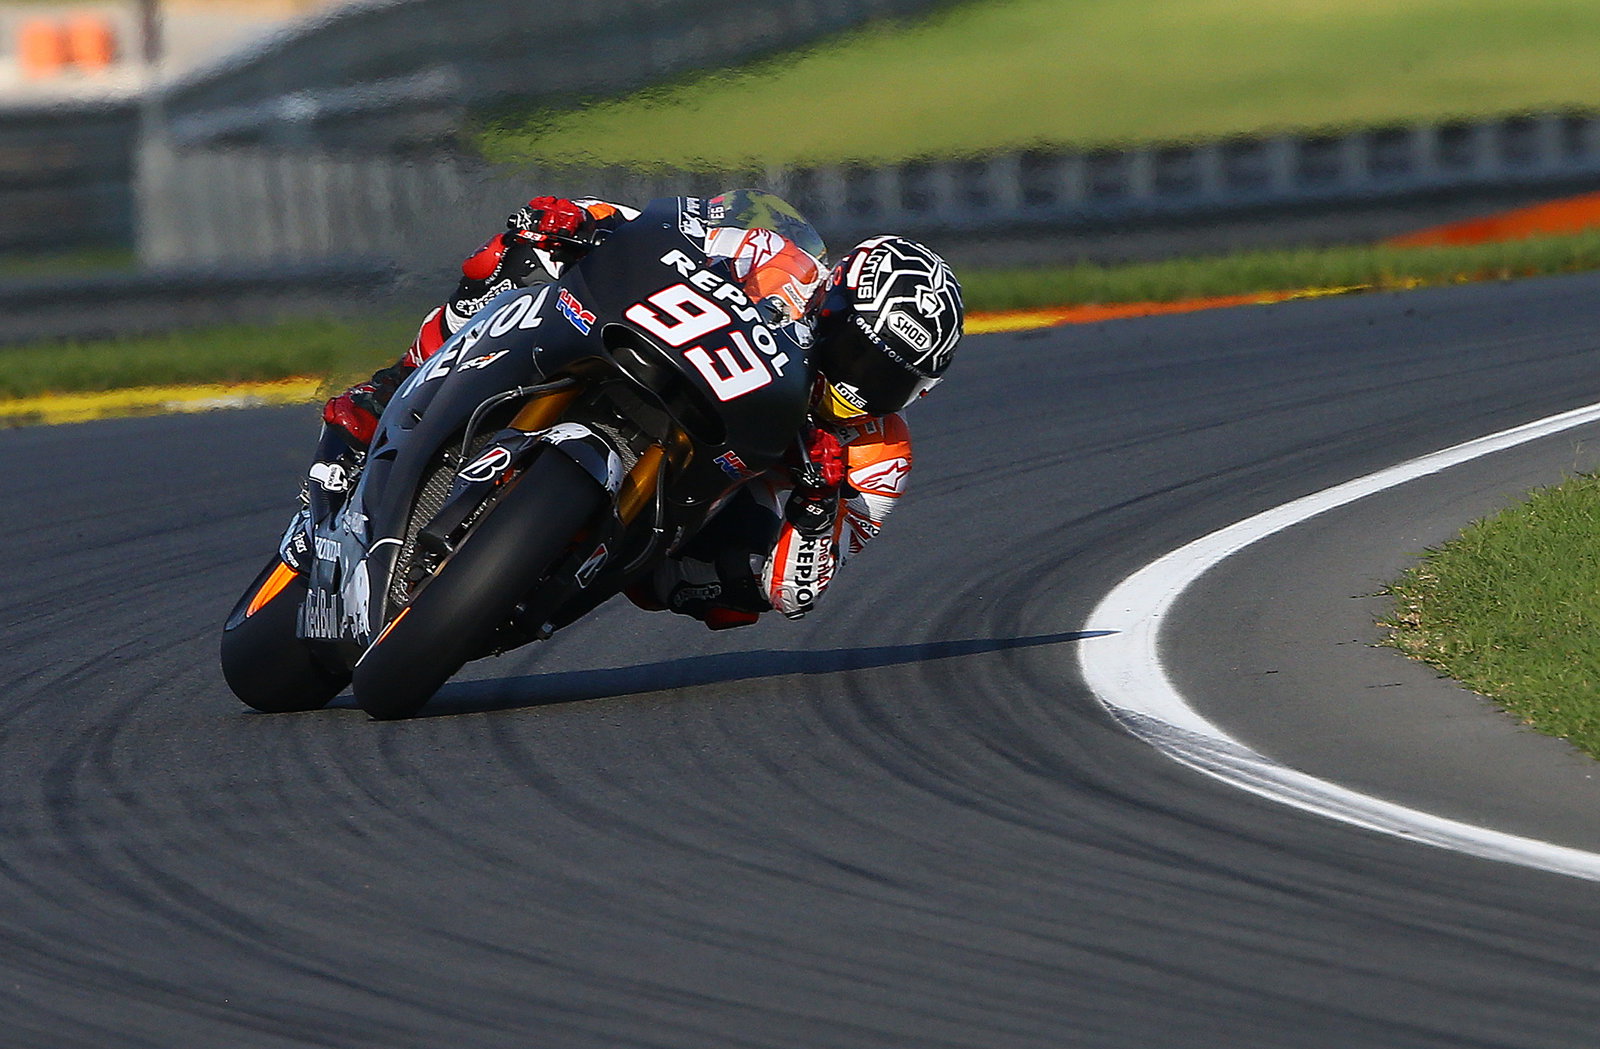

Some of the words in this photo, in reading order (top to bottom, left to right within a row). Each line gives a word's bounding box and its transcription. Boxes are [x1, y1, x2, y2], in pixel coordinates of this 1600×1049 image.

[523, 231, 544, 241] 93
[857, 248, 889, 299] LOTUS
[659, 249, 790, 377] REPSOL
[625, 283, 773, 401] 93
[892, 316, 928, 347] SHOEI
[883, 344, 903, 362] YOU
[834, 382, 867, 409] LOTUS
[805, 504, 825, 515] 93
